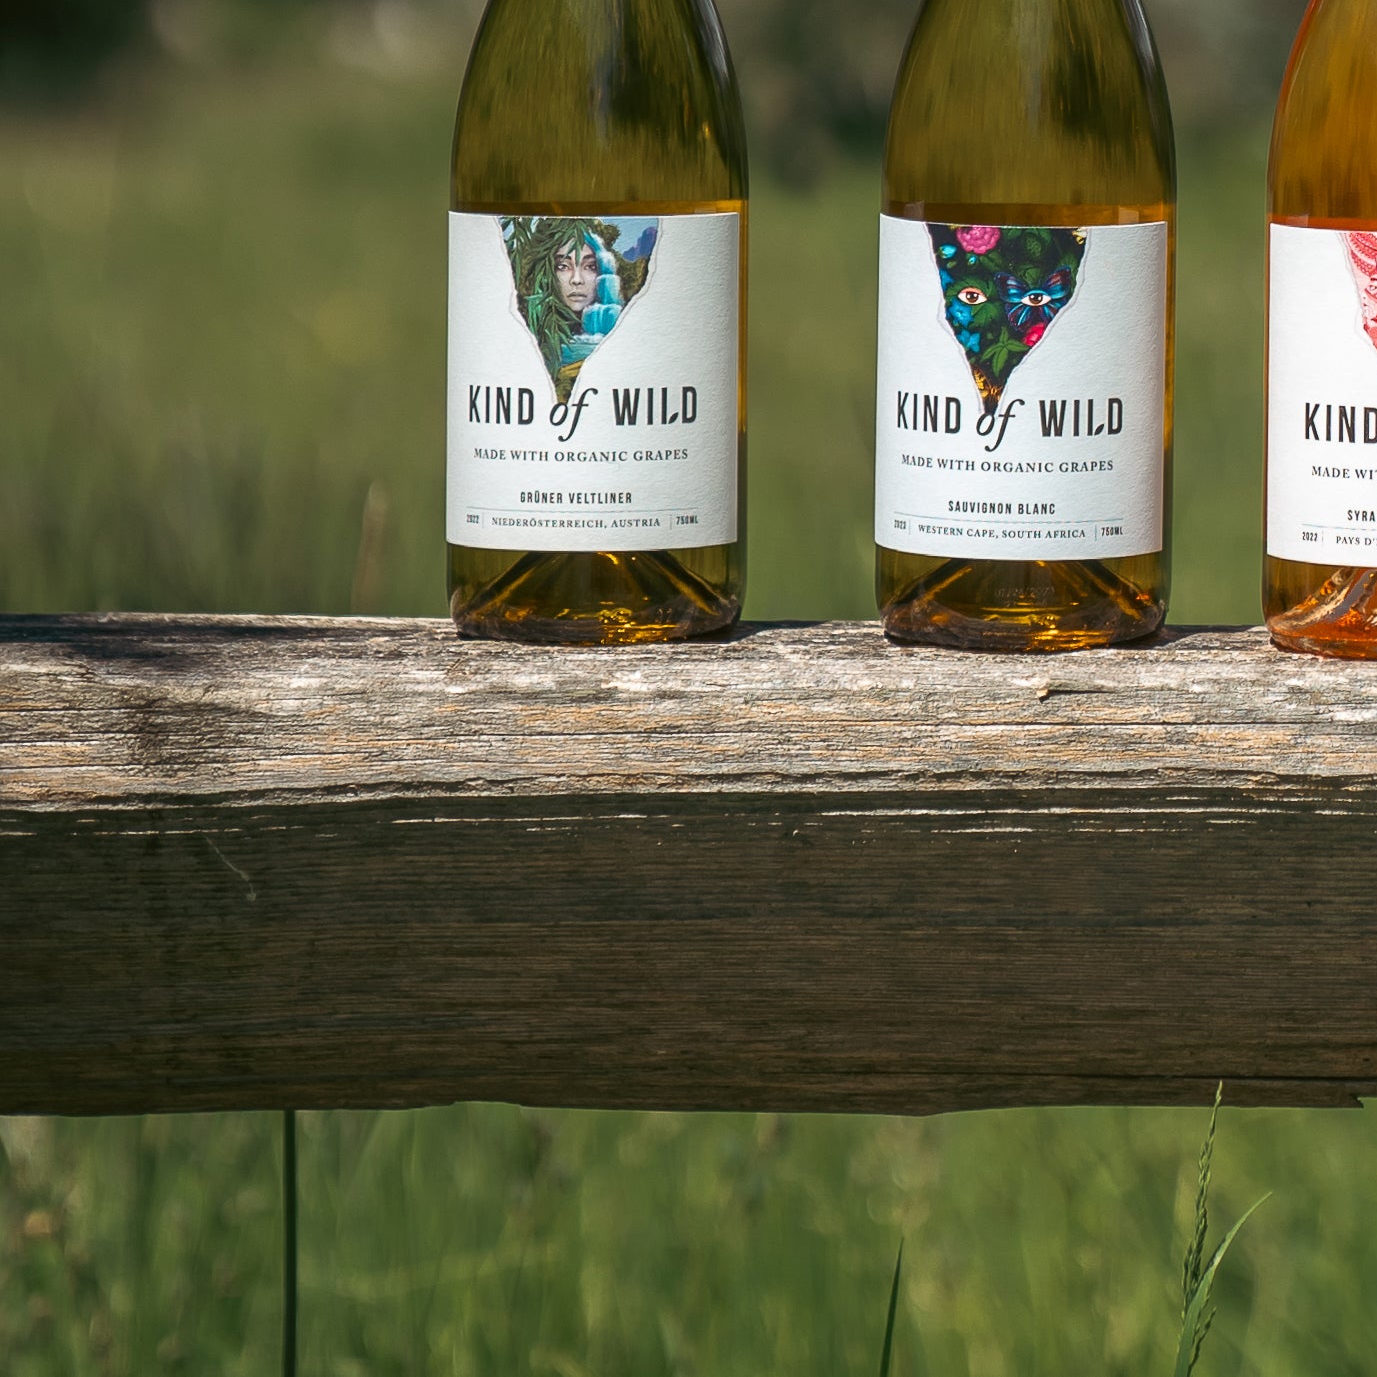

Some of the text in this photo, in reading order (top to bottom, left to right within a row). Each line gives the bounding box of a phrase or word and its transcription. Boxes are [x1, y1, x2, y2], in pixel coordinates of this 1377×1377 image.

[469, 385, 697, 442] KIND of WILD
[897, 390, 1123, 452] KIND of WILD
[473, 448, 688, 462] MADE WITH ORGANIC GRAPES
[901, 454, 1113, 473] MADE WITH ORGANIC GRAPES
[1312, 466, 1350, 479] MADE
[520, 490, 632, 504] GRÜNER VELTLINER
[948, 501, 1056, 515] SAUVIGNON BLANC
[611, 518, 660, 528] AUSTRIA
[918, 524, 1086, 539] WESTERN CAPE, SOUTH AFRICA
[1302, 531, 1318, 542] 2022
[1336, 536, 1360, 546] PAYS
